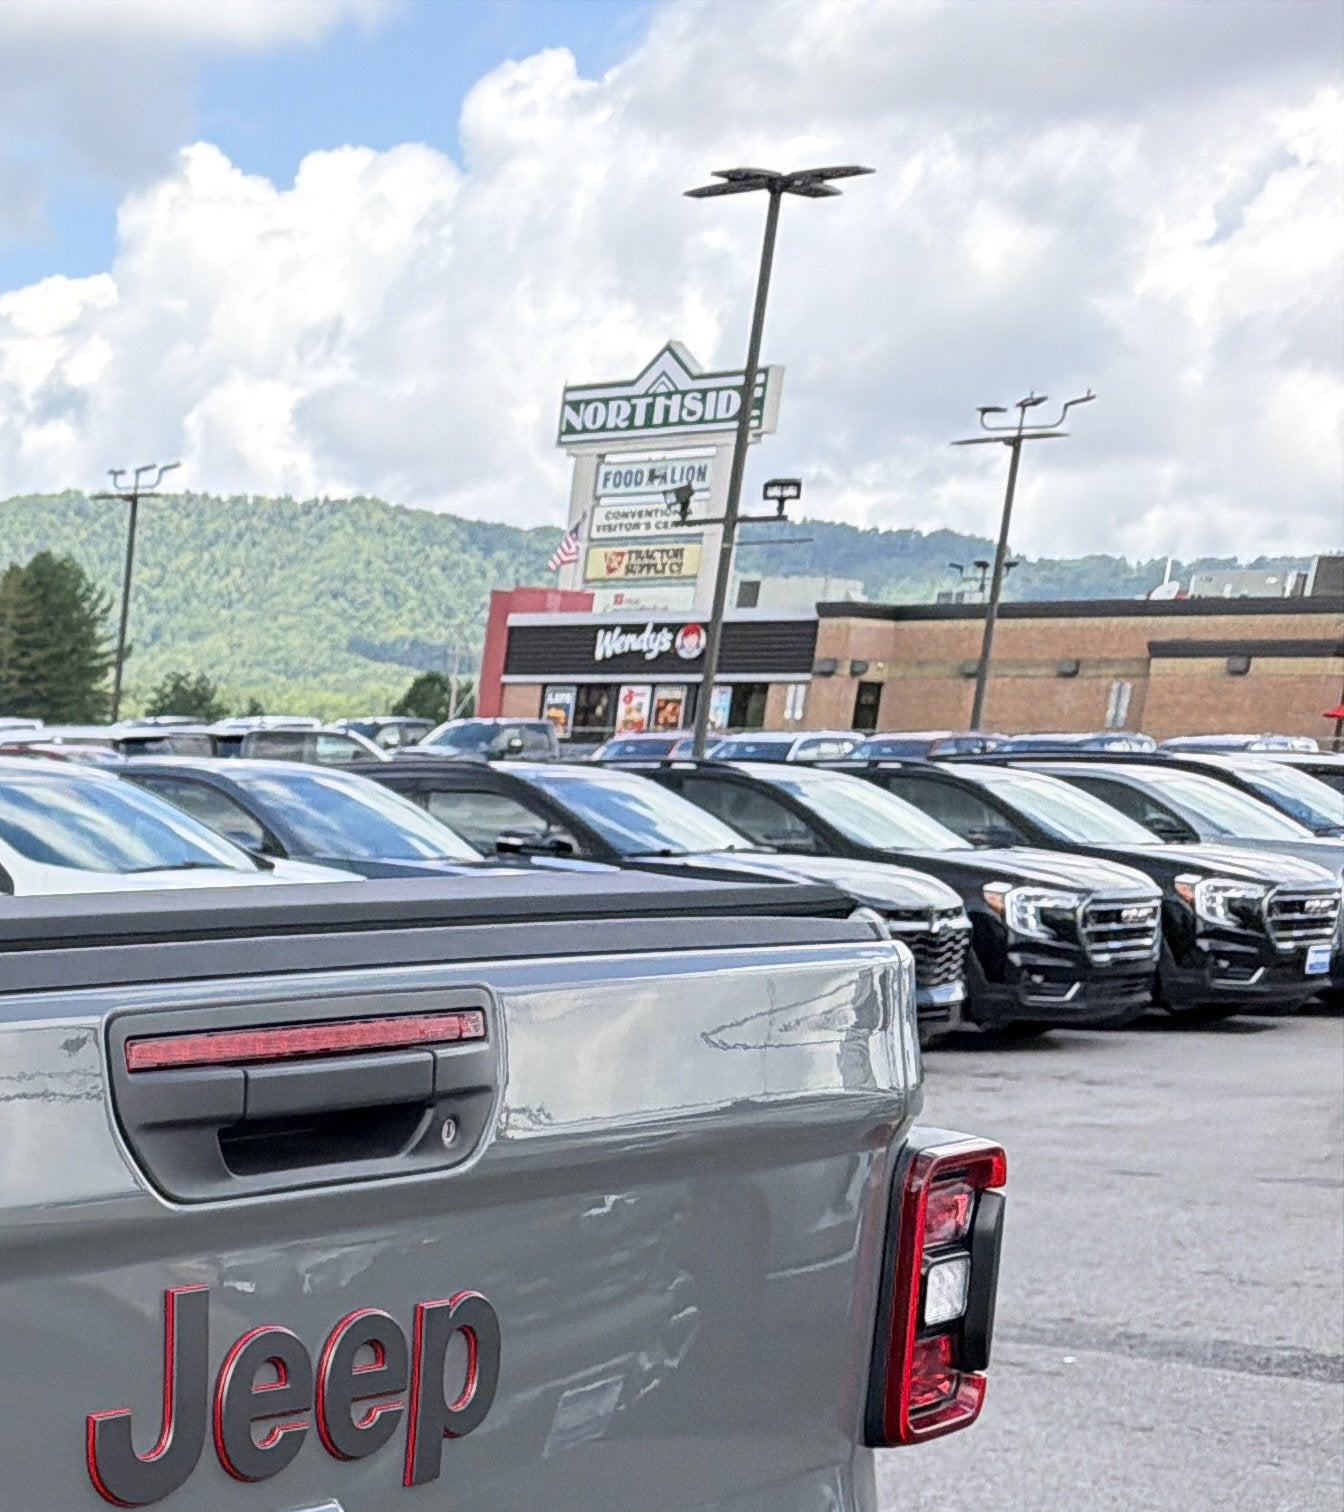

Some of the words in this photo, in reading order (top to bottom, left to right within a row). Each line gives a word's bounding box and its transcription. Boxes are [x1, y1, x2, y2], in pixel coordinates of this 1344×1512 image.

[562, 386, 763, 433] NORTHSID
[602, 469, 645, 489] FOOD
[670, 464, 708, 485] LION
[594, 621, 674, 661] Wendy's
[85, 1283, 501, 1508] Jeep
